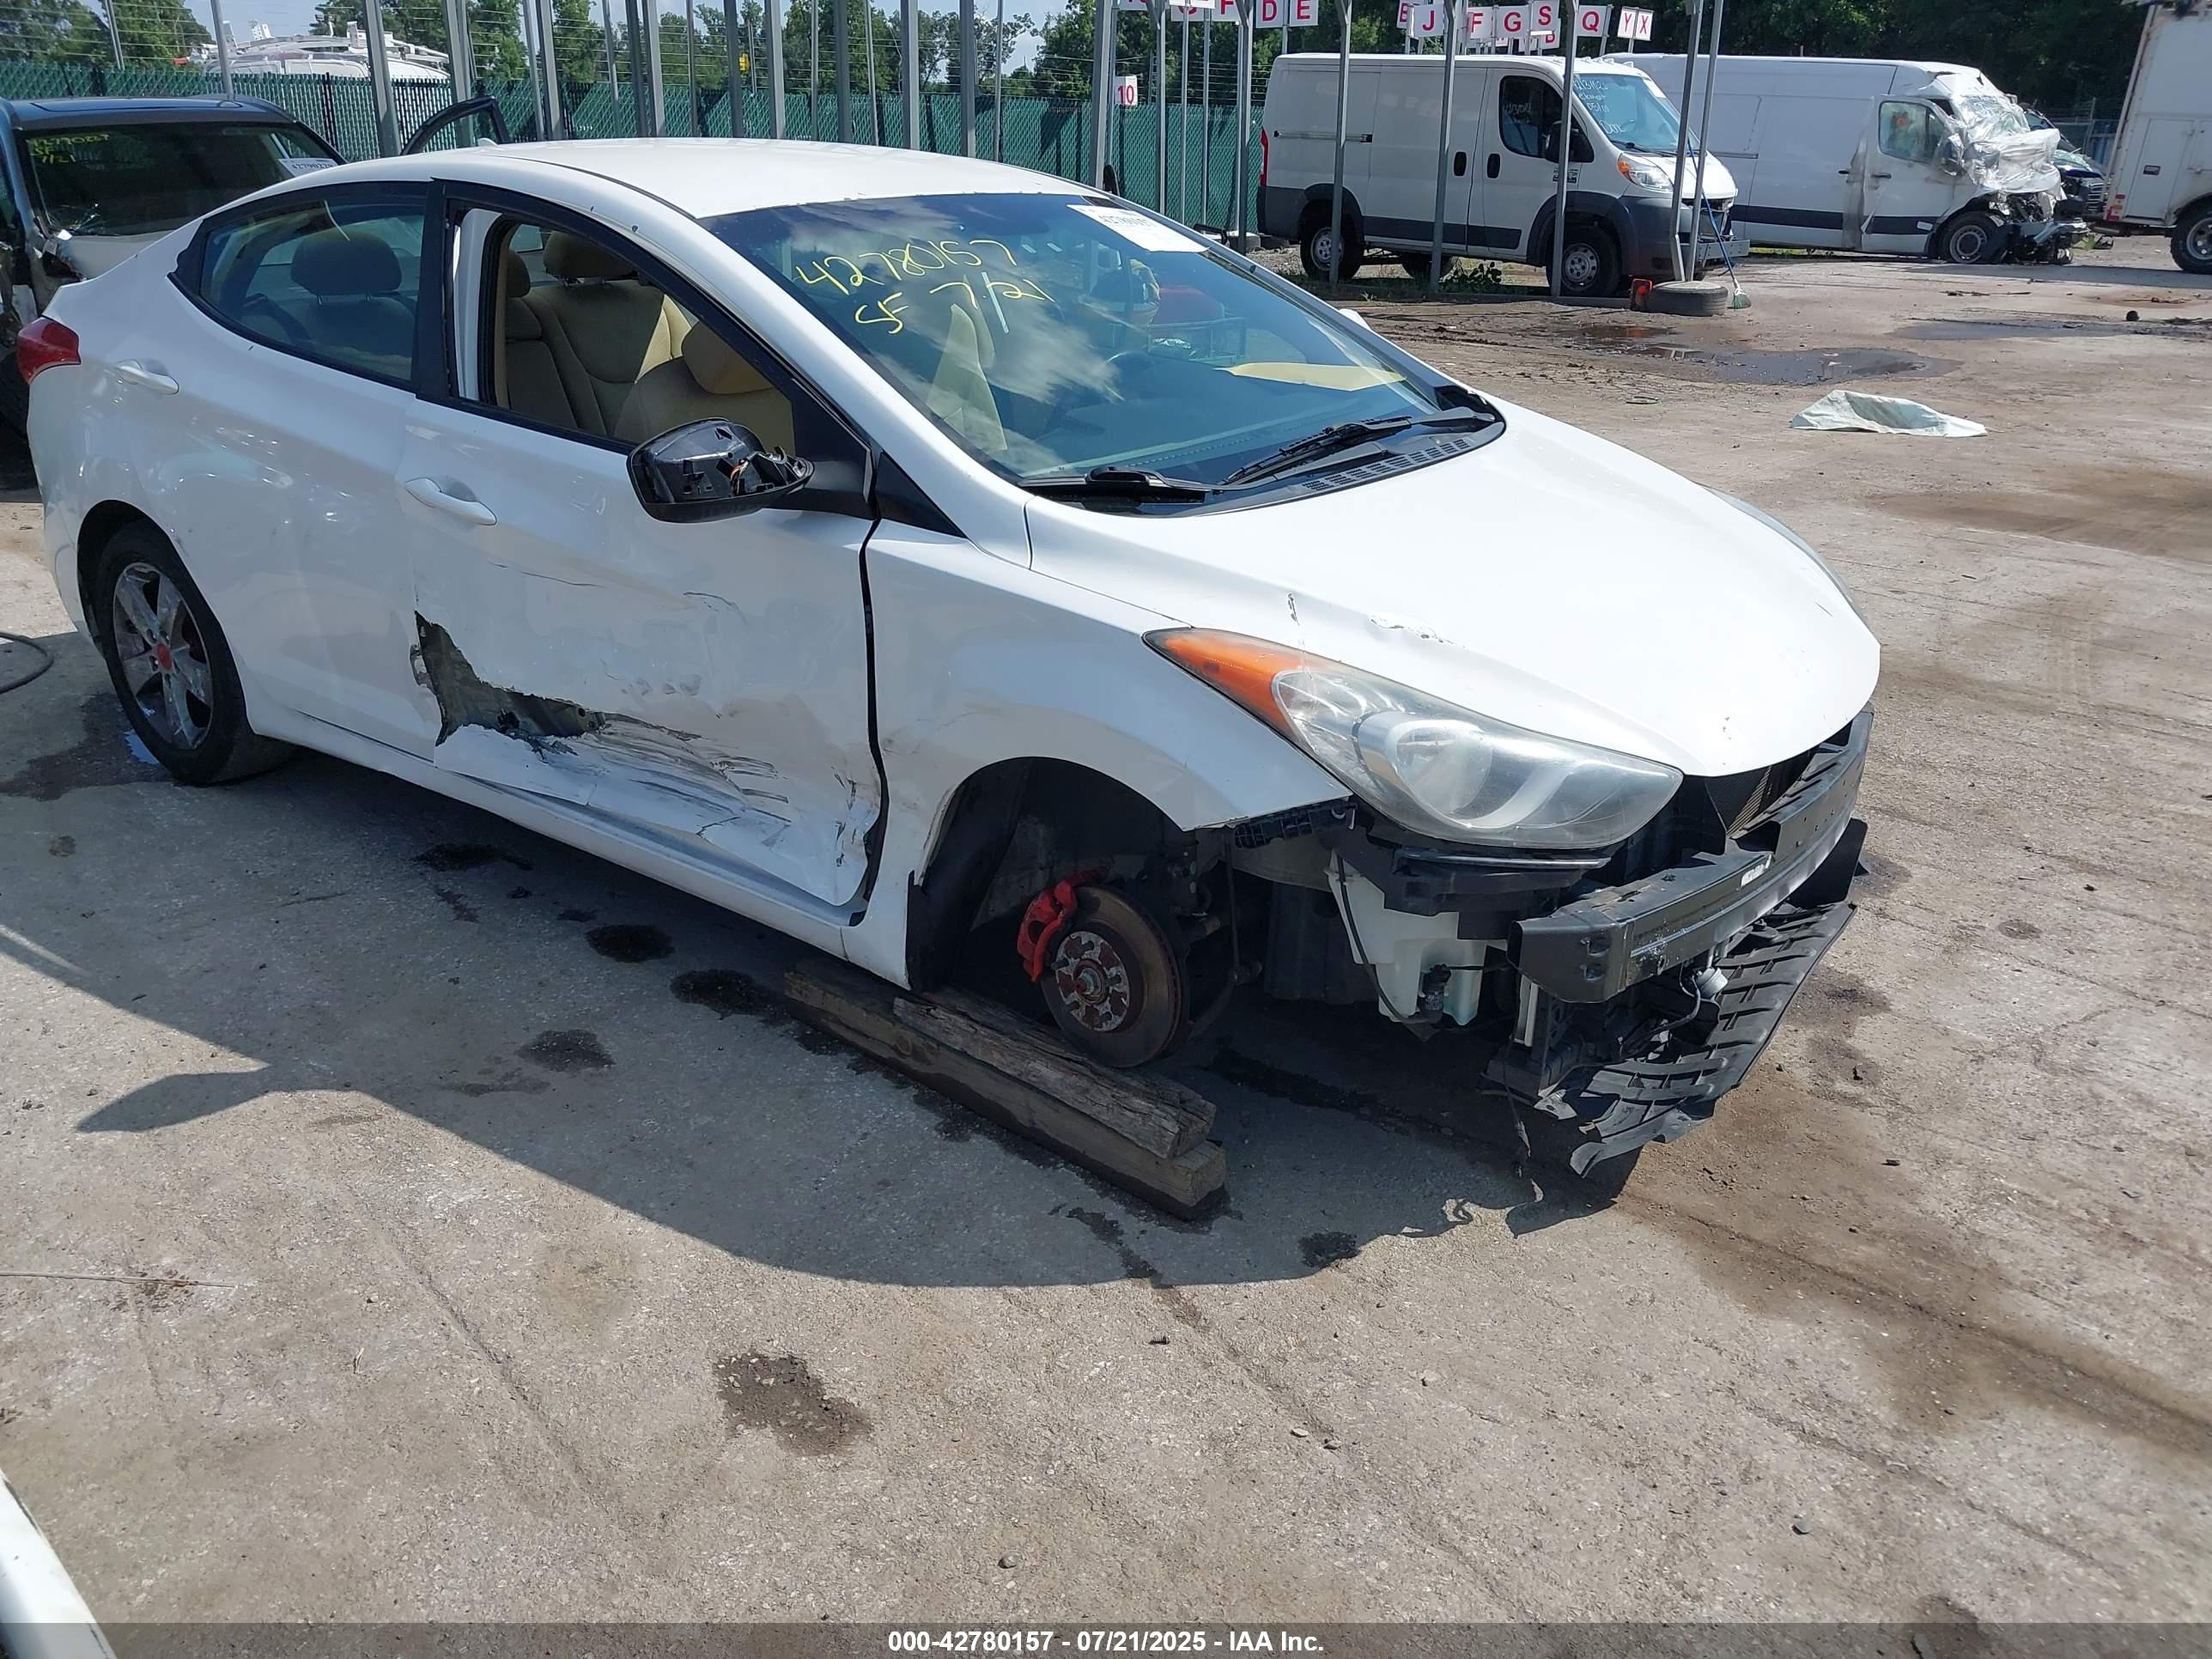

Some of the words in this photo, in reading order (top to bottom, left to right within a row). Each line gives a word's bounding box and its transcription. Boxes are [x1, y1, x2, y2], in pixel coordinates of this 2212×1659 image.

[1261, 0, 1278, 21] D
[1297, 0, 1311, 20] E
[1422, 10, 1435, 31] J
[1538, 5, 1552, 26] S
[1582, 10, 1600, 32] Q
[1471, 13, 1484, 33] F
[1504, 12, 1522, 33] G
[1639, 15, 1650, 34] X
[1117, 84, 1134, 105] 10
[795, 240, 1018, 295] 42780157
